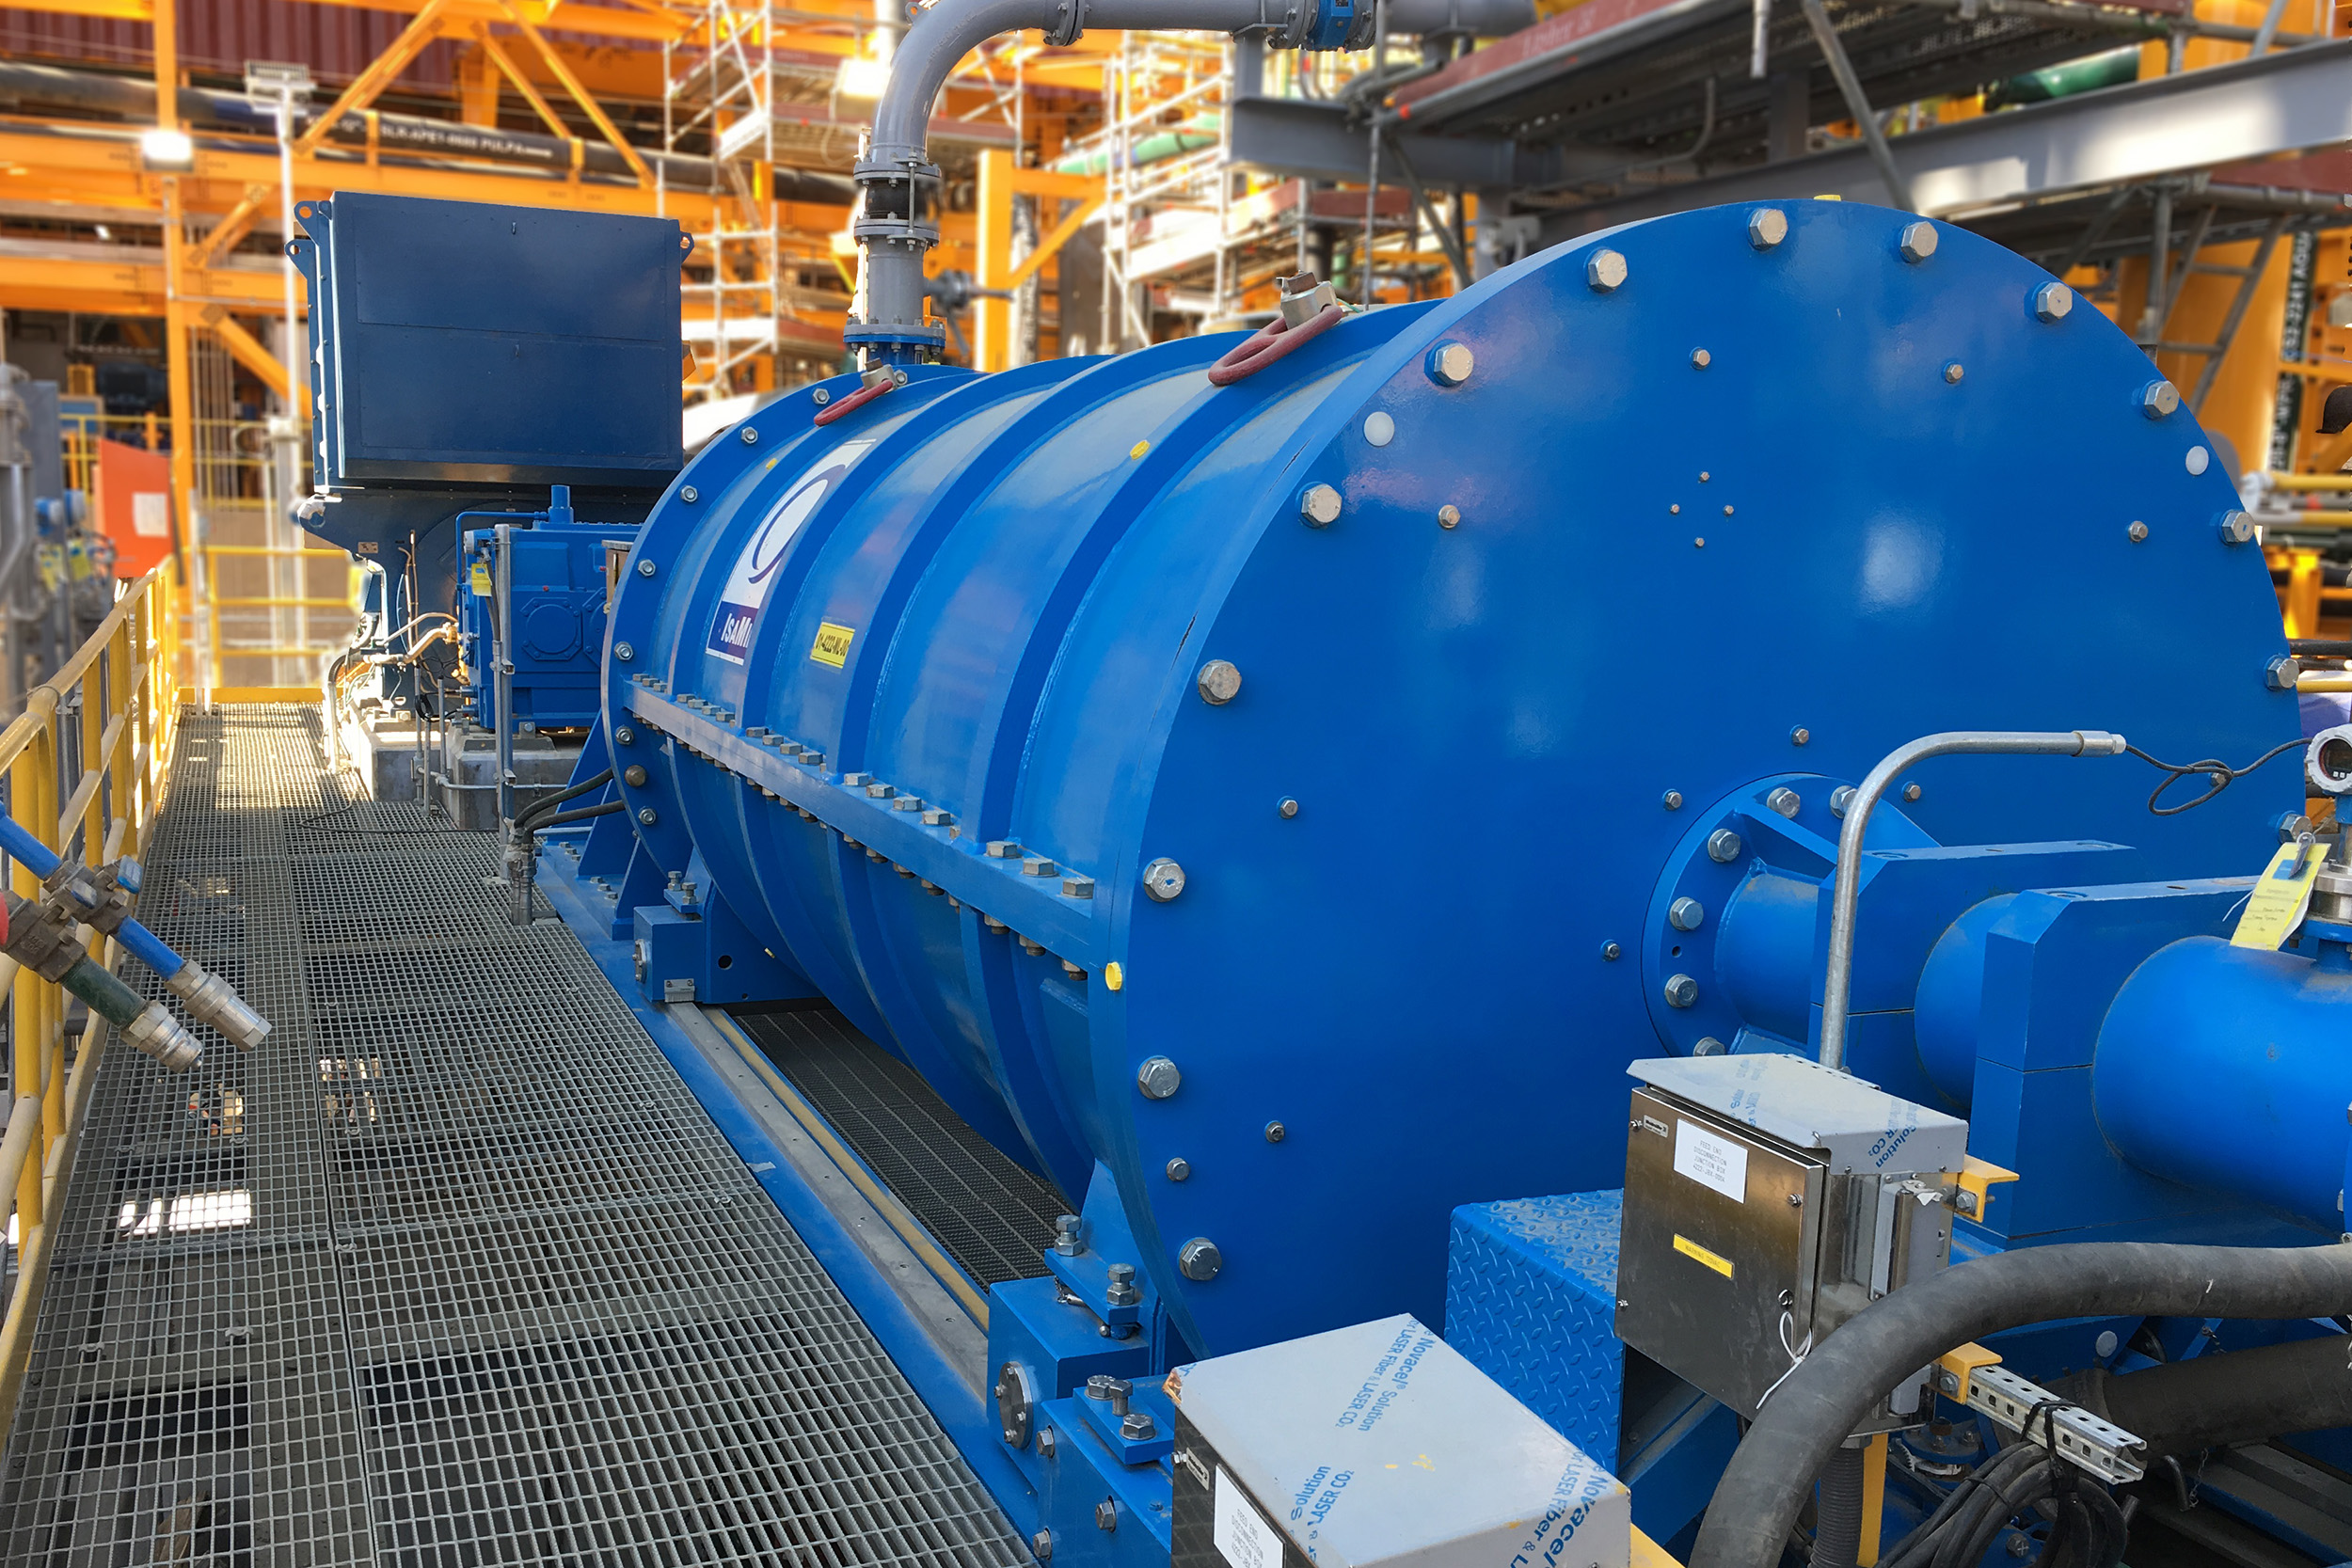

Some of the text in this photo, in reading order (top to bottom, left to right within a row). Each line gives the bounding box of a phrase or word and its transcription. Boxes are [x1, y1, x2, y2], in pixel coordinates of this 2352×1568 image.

[1693, 1146, 1727, 1166] DISCONNECTION
[1700, 1140, 1723, 1156] FEED END
[1694, 1156, 1725, 1174] JUNCTION BOX
[1388, 1329, 1416, 1354] LASER
[1374, 1354, 1398, 1376] Fiber
[1348, 1382, 1379, 1410] LASER
[1358, 1390, 1398, 1432] Solution
[1555, 1462, 1584, 1497] LASER
[1291, 1465, 1331, 1521] Solution
[1307, 1490, 1342, 1527] LASER
[1534, 1497, 1568, 1542] Fiber
[1521, 1540, 1536, 1552] &
